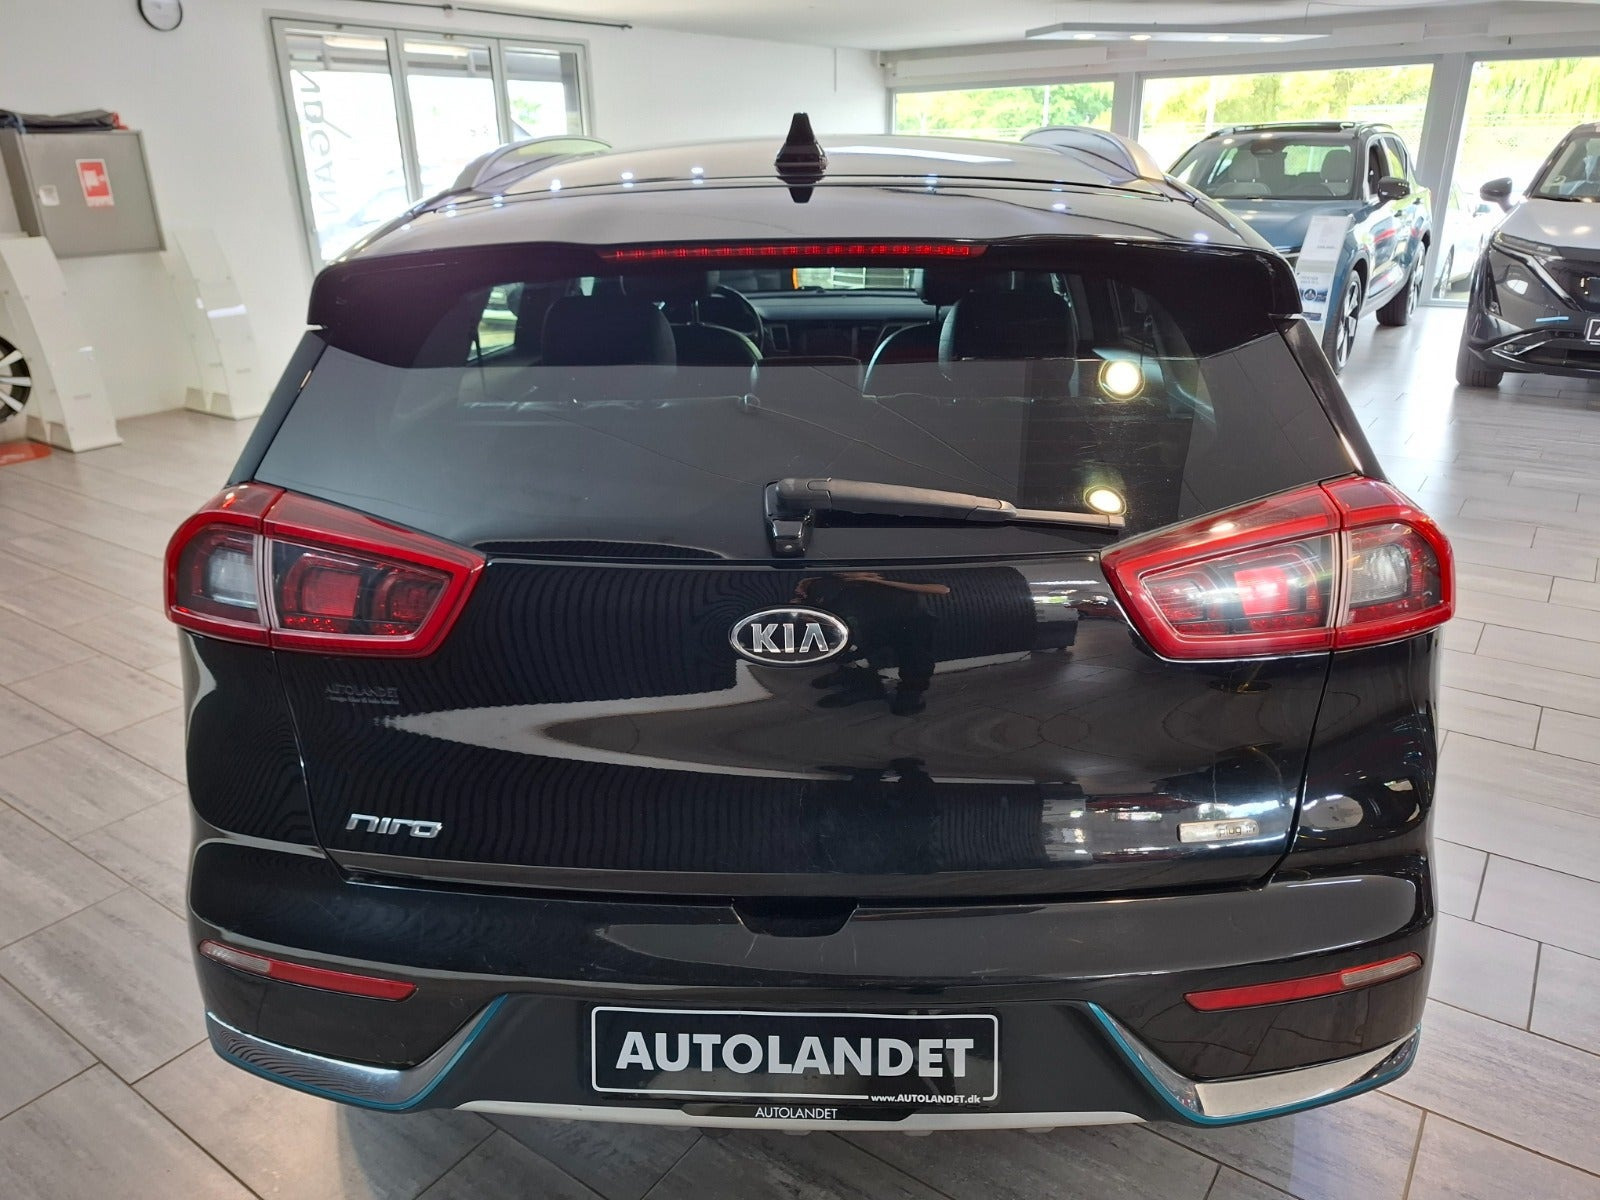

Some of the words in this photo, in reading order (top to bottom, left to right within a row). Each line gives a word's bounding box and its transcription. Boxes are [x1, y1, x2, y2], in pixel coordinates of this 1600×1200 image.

[750, 623, 829, 653] KIA
[615, 1030, 975, 1078] AUTOLANDET
[870, 1094, 981, 1104] www.AUTOLANDET.dk
[755, 1106, 838, 1119] AUTOLANDET
